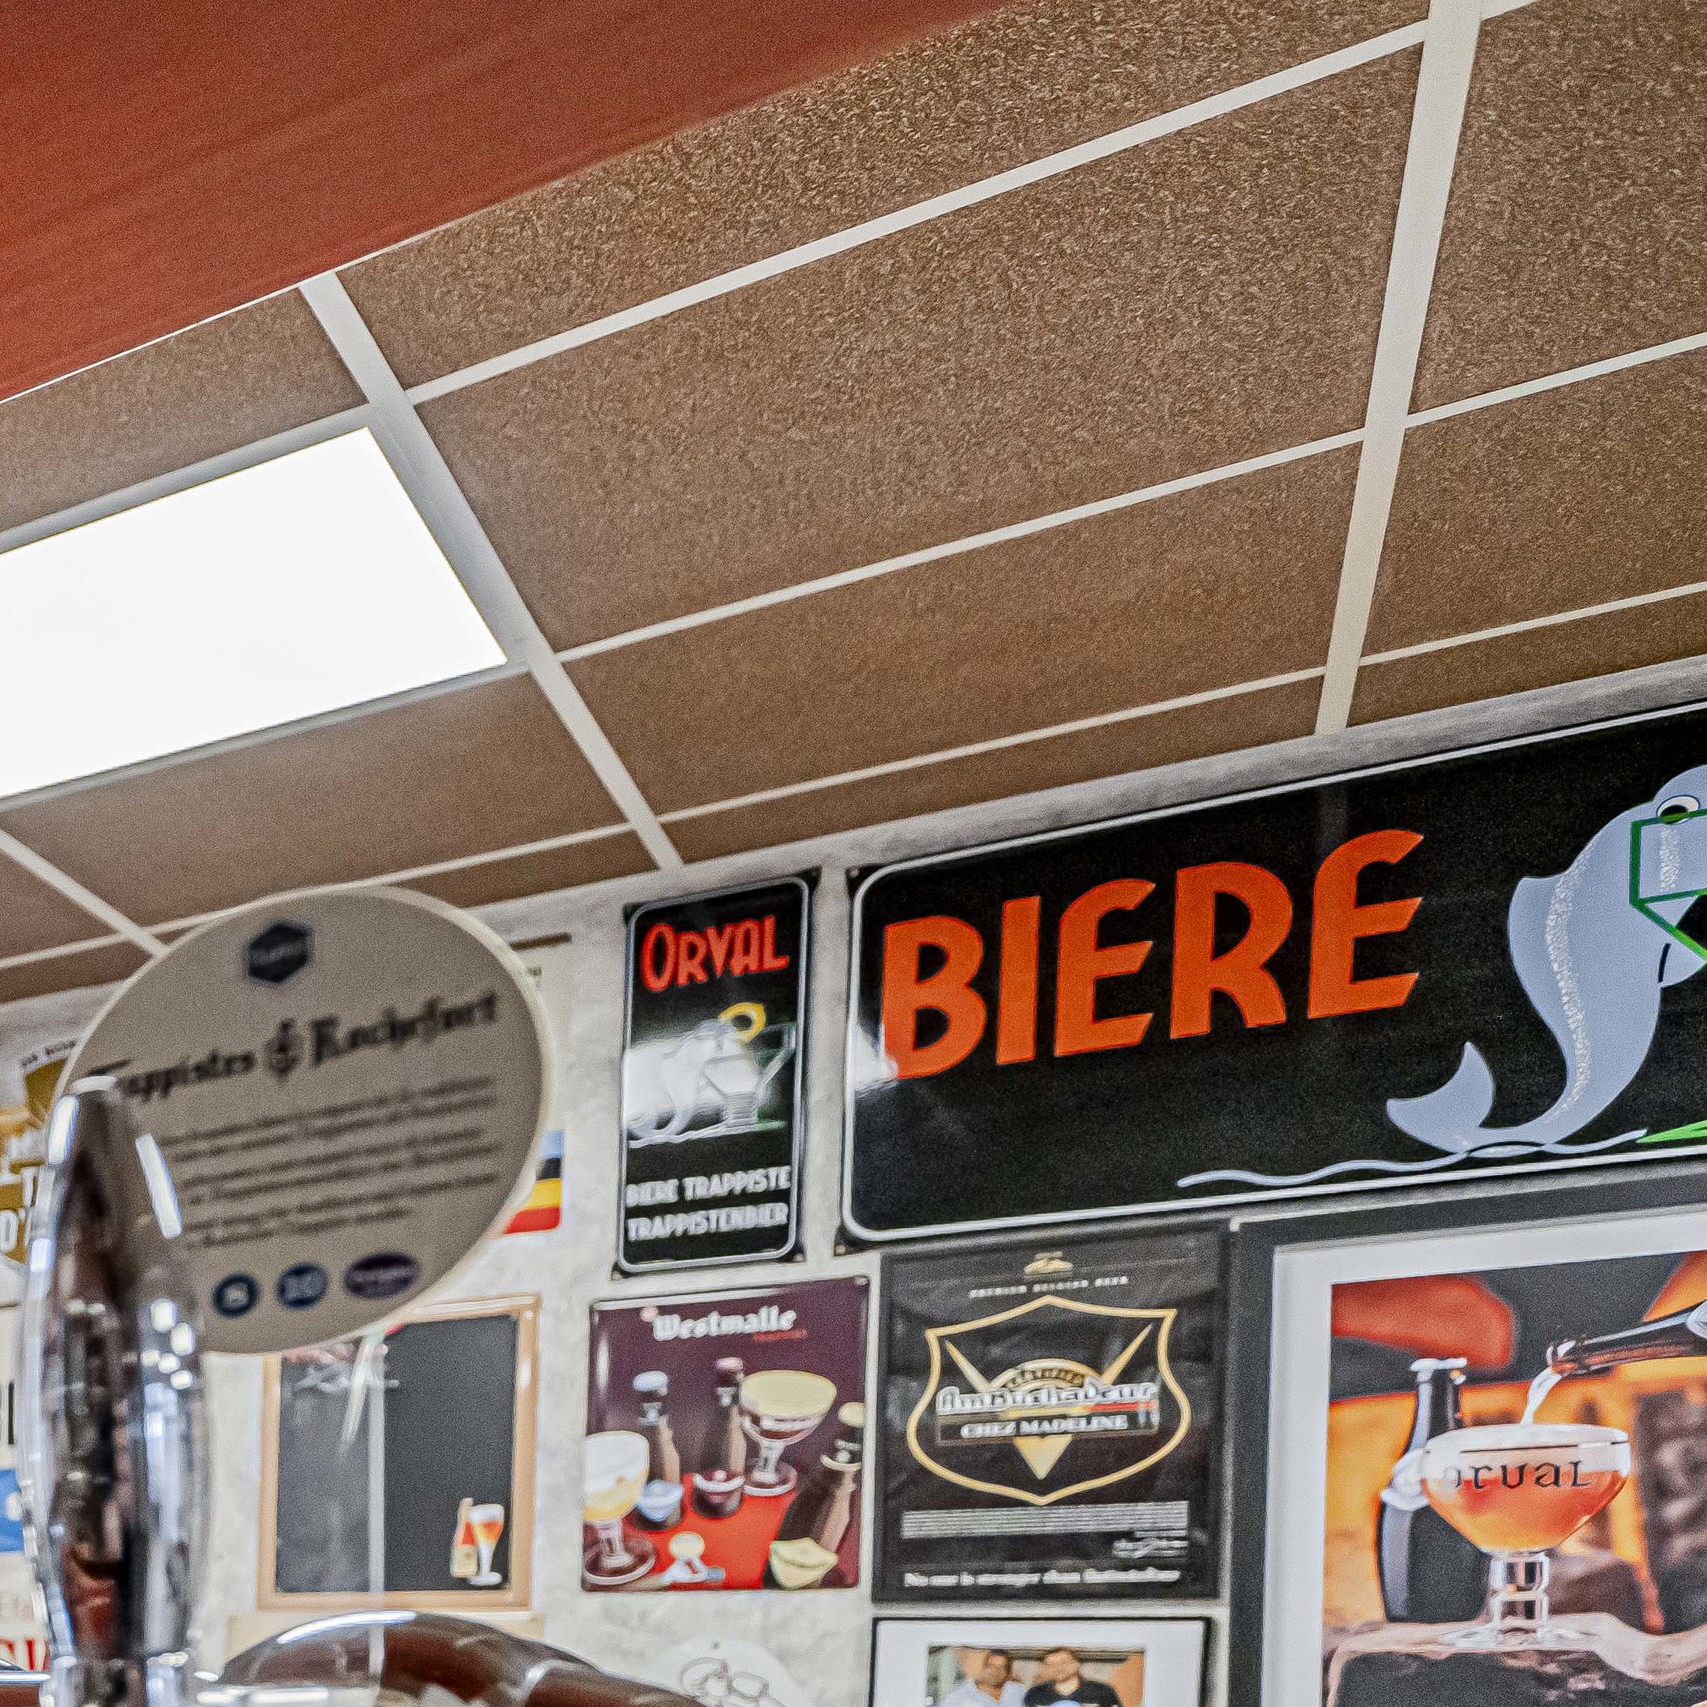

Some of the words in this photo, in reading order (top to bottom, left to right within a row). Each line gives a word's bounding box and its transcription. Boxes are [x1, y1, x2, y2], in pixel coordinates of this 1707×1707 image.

[641, 915, 790, 992] ORVAL
[881, 829, 1425, 1081] BIERE
[682, 1165, 792, 1201] TRAPPISTE
[653, 1304, 797, 1342] Westmalle
[1019, 1414, 1128, 1436] MADELINE
